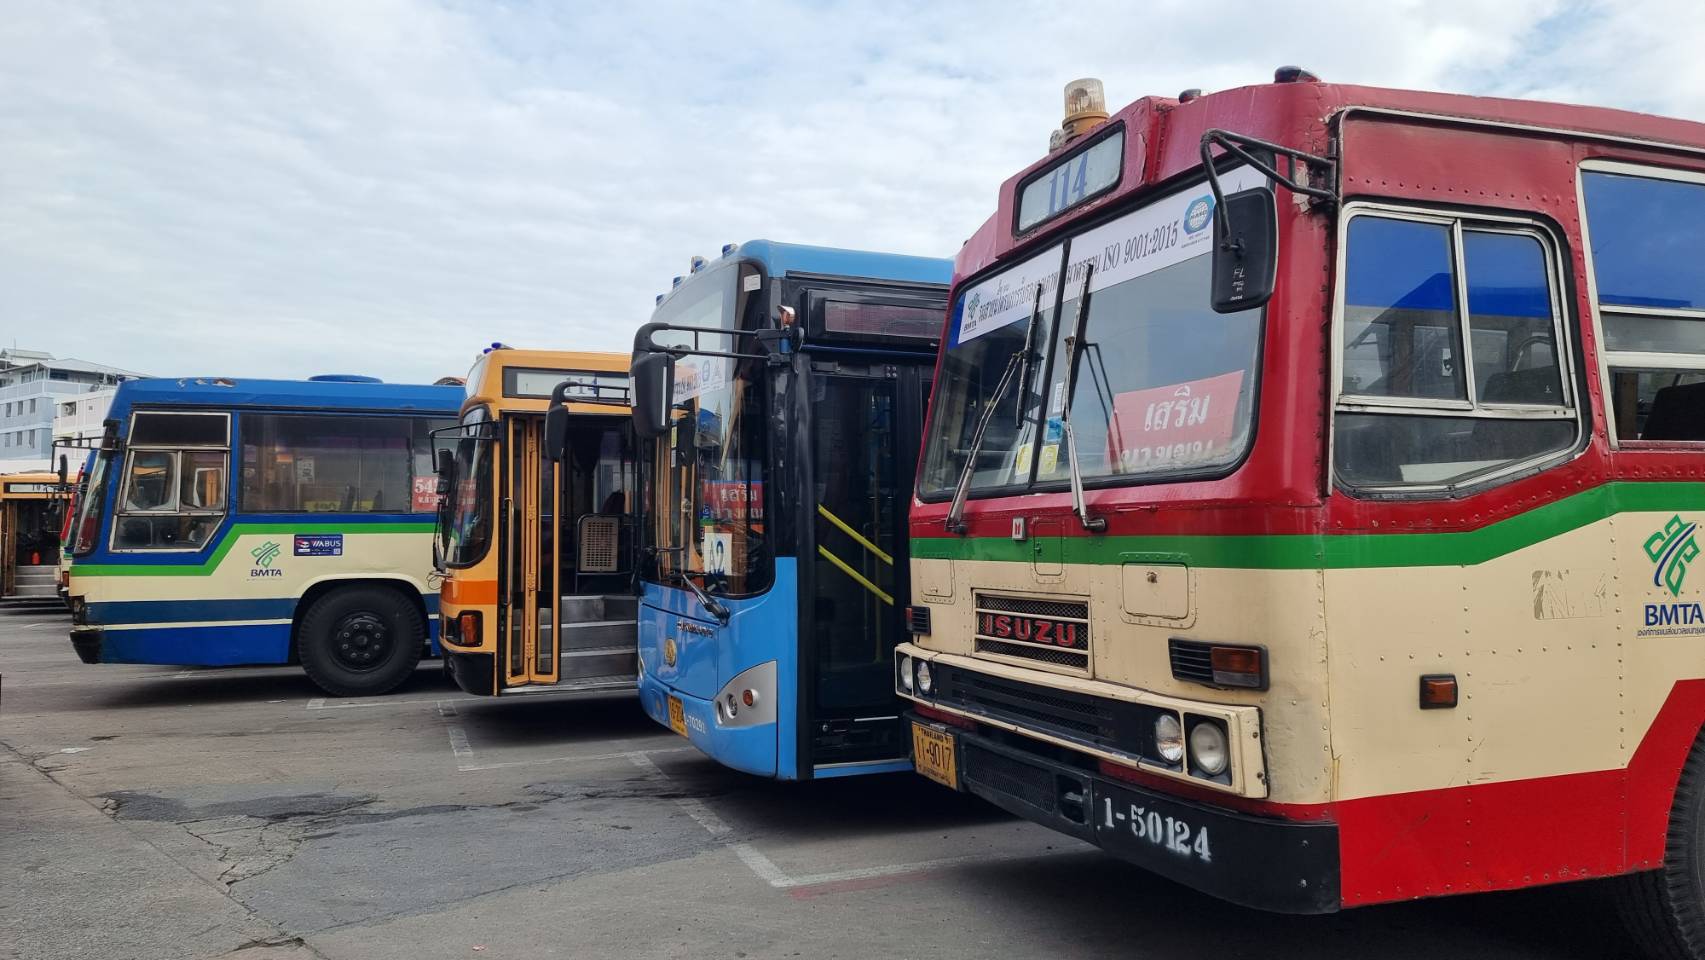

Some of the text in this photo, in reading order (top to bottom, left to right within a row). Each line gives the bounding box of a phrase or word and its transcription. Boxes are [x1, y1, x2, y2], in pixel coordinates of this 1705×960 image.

[1048, 152, 1089, 216] 114
[1101, 243, 1121, 273] ISO
[1123, 219, 1181, 265] 9001:2015
[565, 376, 599, 395] 114
[1144, 385, 1210, 432] เสริม
[250, 568, 283, 577] BMTA
[984, 614, 1077, 647] ISUZU
[1644, 603, 1705, 627] BMTA
[916, 735, 952, 771] 11-9017
[1104, 797, 1212, 862] 1-50124
